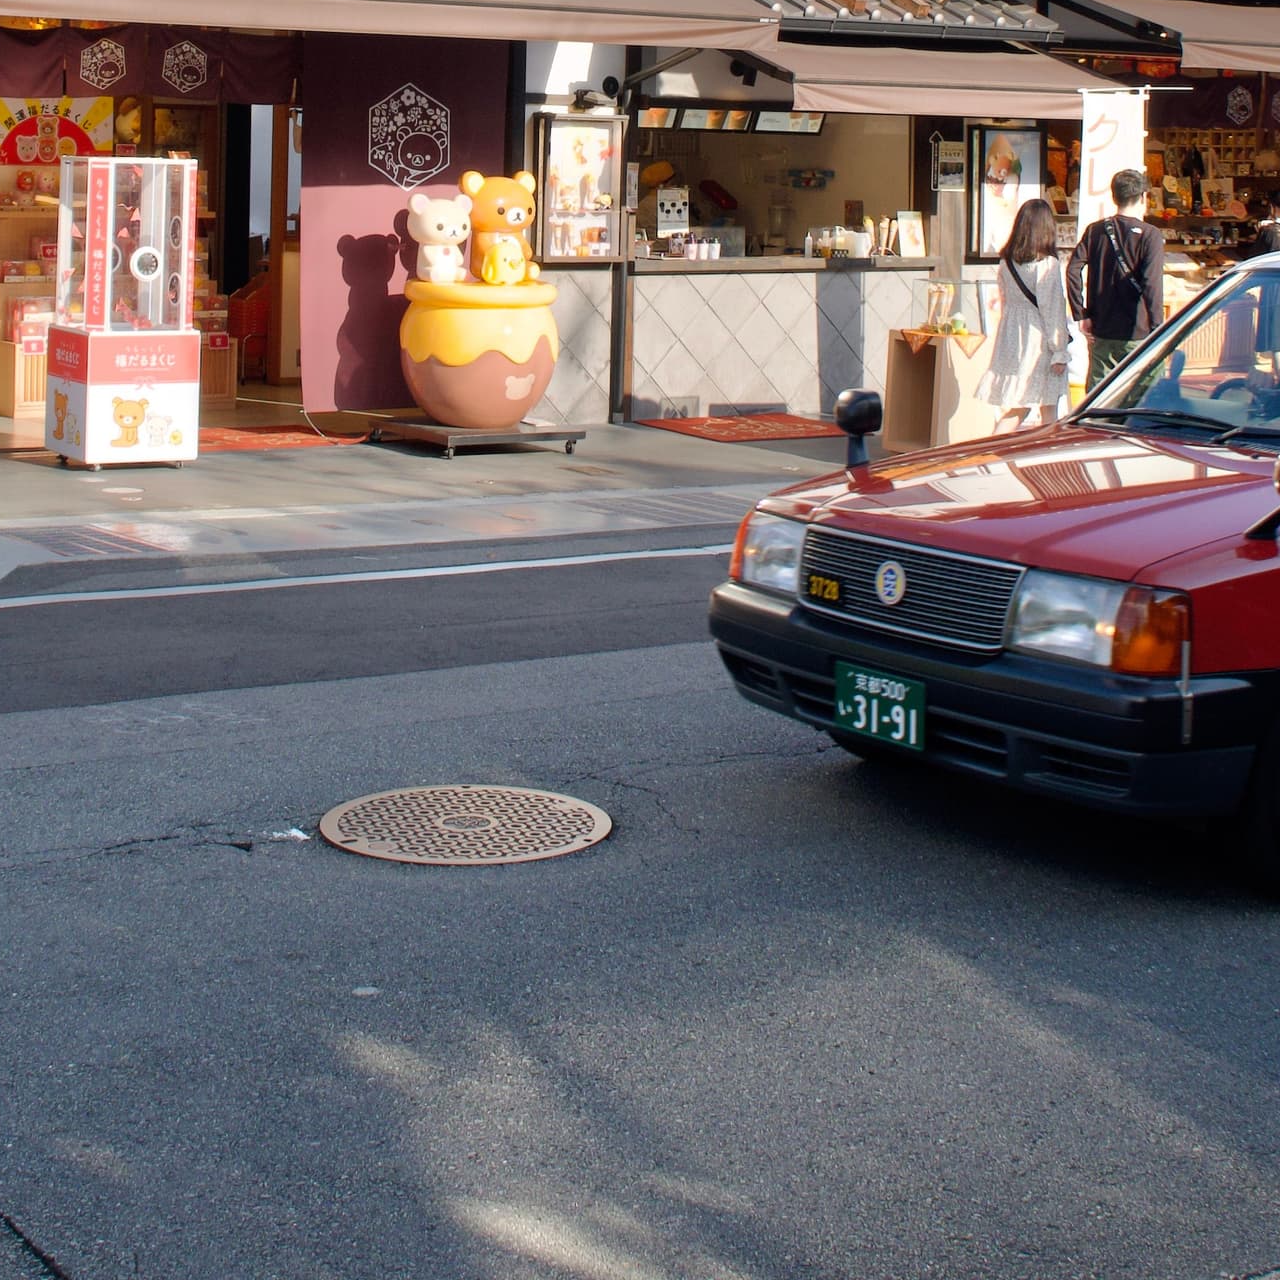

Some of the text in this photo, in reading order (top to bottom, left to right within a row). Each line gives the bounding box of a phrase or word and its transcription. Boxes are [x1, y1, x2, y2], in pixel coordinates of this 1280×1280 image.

[115, 353, 177, 368] 福だるまくじ
[809, 575, 840, 601] 3728
[853, 694, 917, 745] 31-91
